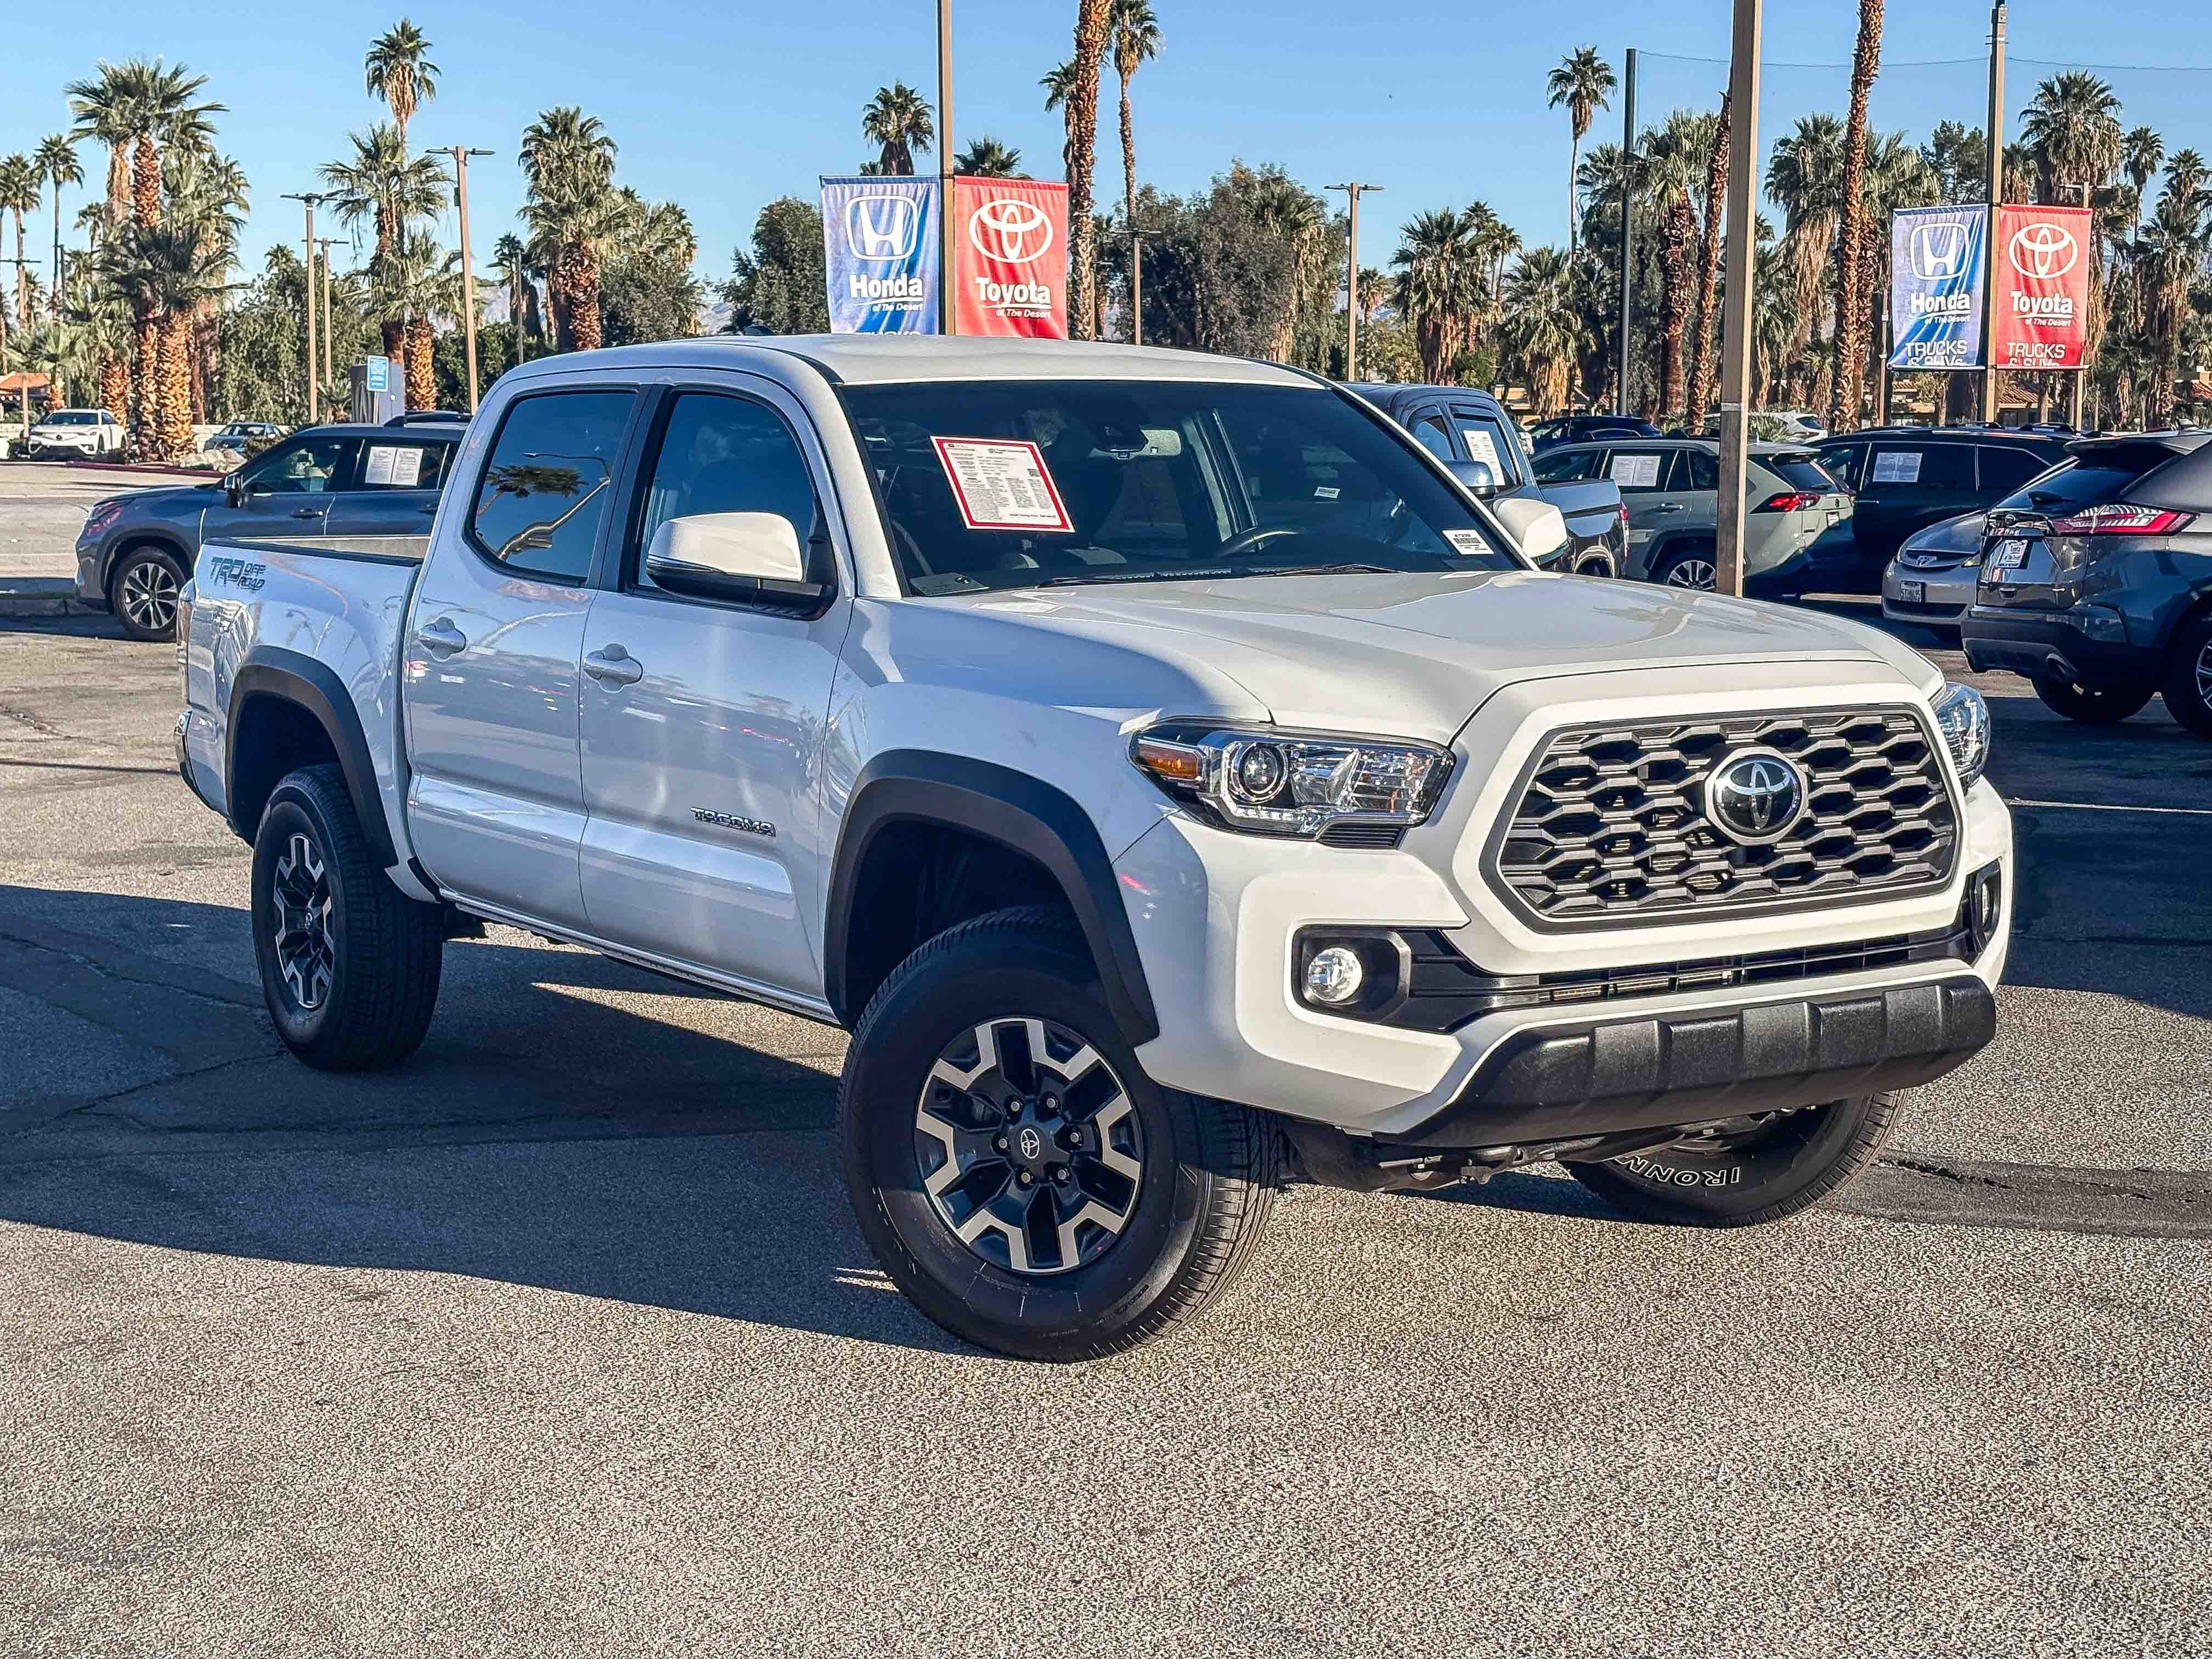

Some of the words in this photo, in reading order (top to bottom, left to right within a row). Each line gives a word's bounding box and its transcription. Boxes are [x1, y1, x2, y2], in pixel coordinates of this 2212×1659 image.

[849, 272, 923, 298] Honda
[975, 276, 1051, 307] Toyota
[872, 303, 882, 312] of
[882, 302, 895, 312] The
[896, 302, 923, 312] Desert
[1910, 290, 1971, 313] Honda
[2010, 290, 2073, 317] Toyota
[996, 308, 1005, 317] of
[1006, 308, 1023, 318] The
[1023, 308, 1051, 319] Desert
[1924, 316, 1933, 325] of
[1949, 315, 1971, 324] Desert
[2033, 318, 2047, 326] The
[2047, 319, 2072, 328] Desert
[1905, 339, 1967, 357] TRUCKS
[2006, 342, 2066, 359] TRUCKS
[211, 557, 245, 586] TRD
[244, 563, 266, 576] OFF
[237, 576, 266, 590] ROAD
[690, 806, 776, 837] TACOMA
